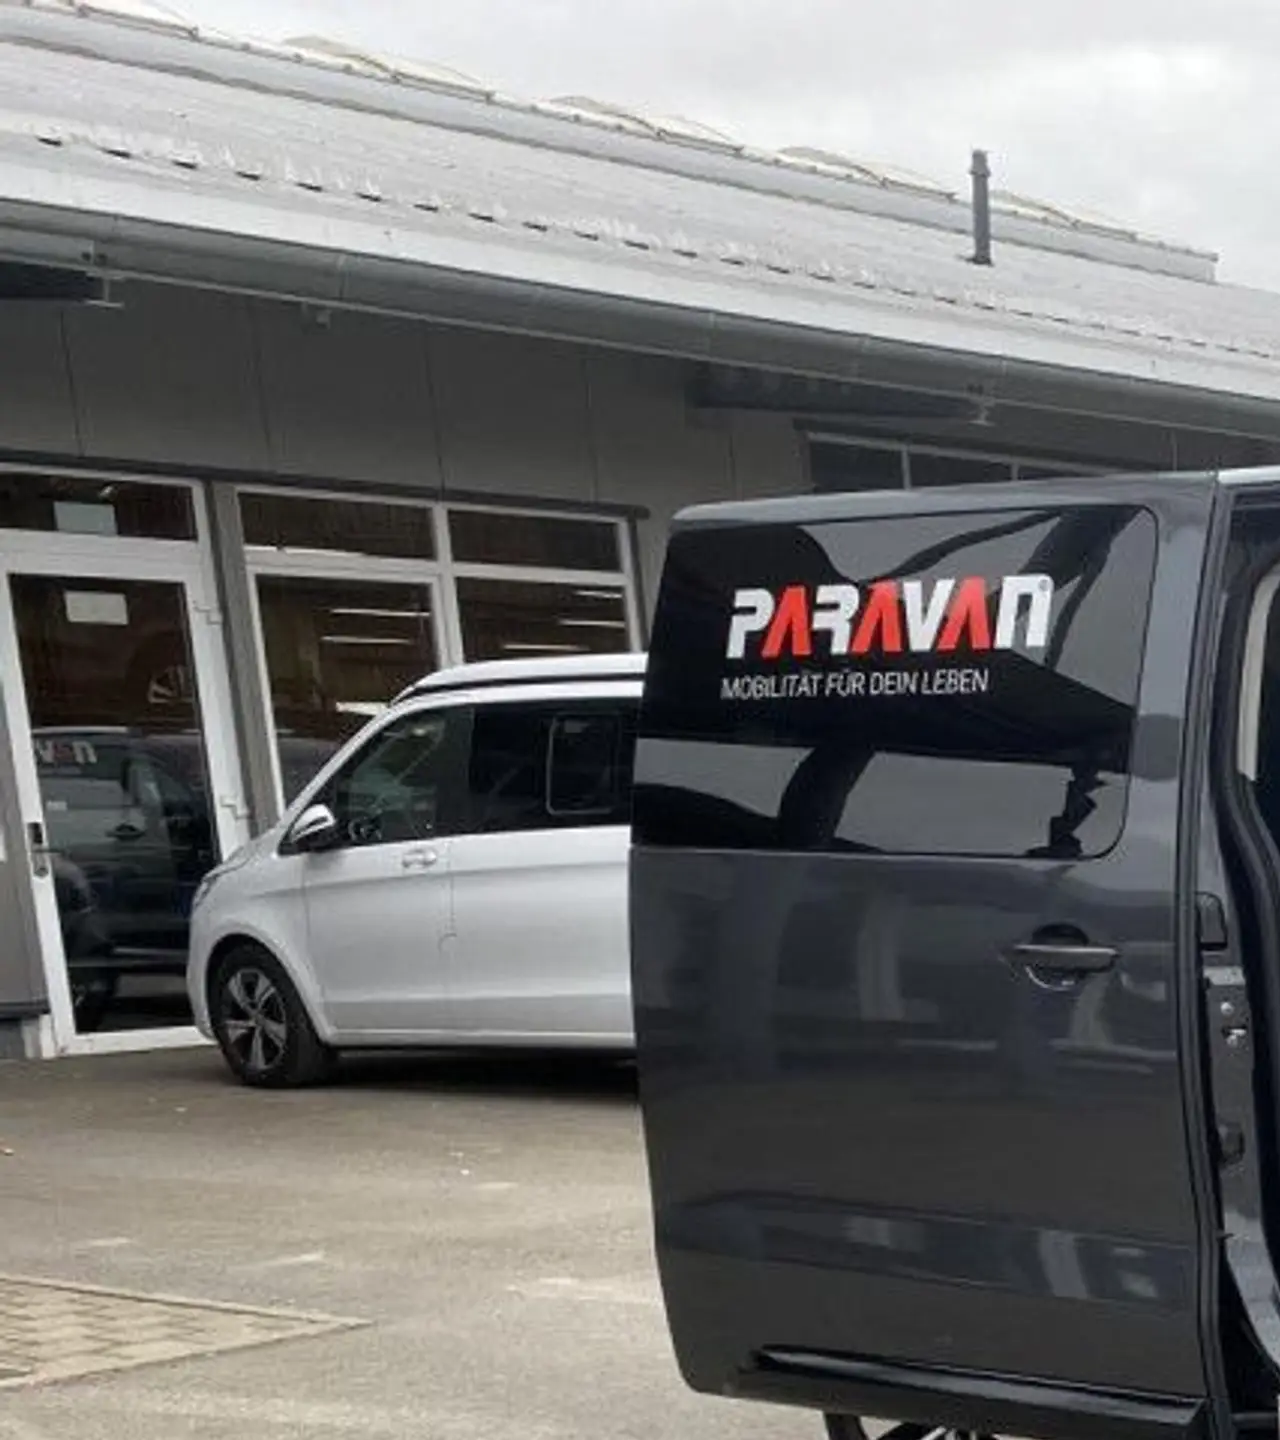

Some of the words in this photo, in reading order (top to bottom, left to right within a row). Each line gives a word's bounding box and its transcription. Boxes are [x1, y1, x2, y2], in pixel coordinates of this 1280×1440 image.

[726, 574, 1055, 660] PARAVAN
[720, 670, 823, 700] MOBILITÄT
[825, 669, 866, 697] FÜR
[869, 672, 919, 695] DEIN
[921, 668, 989, 695] LEBEN
